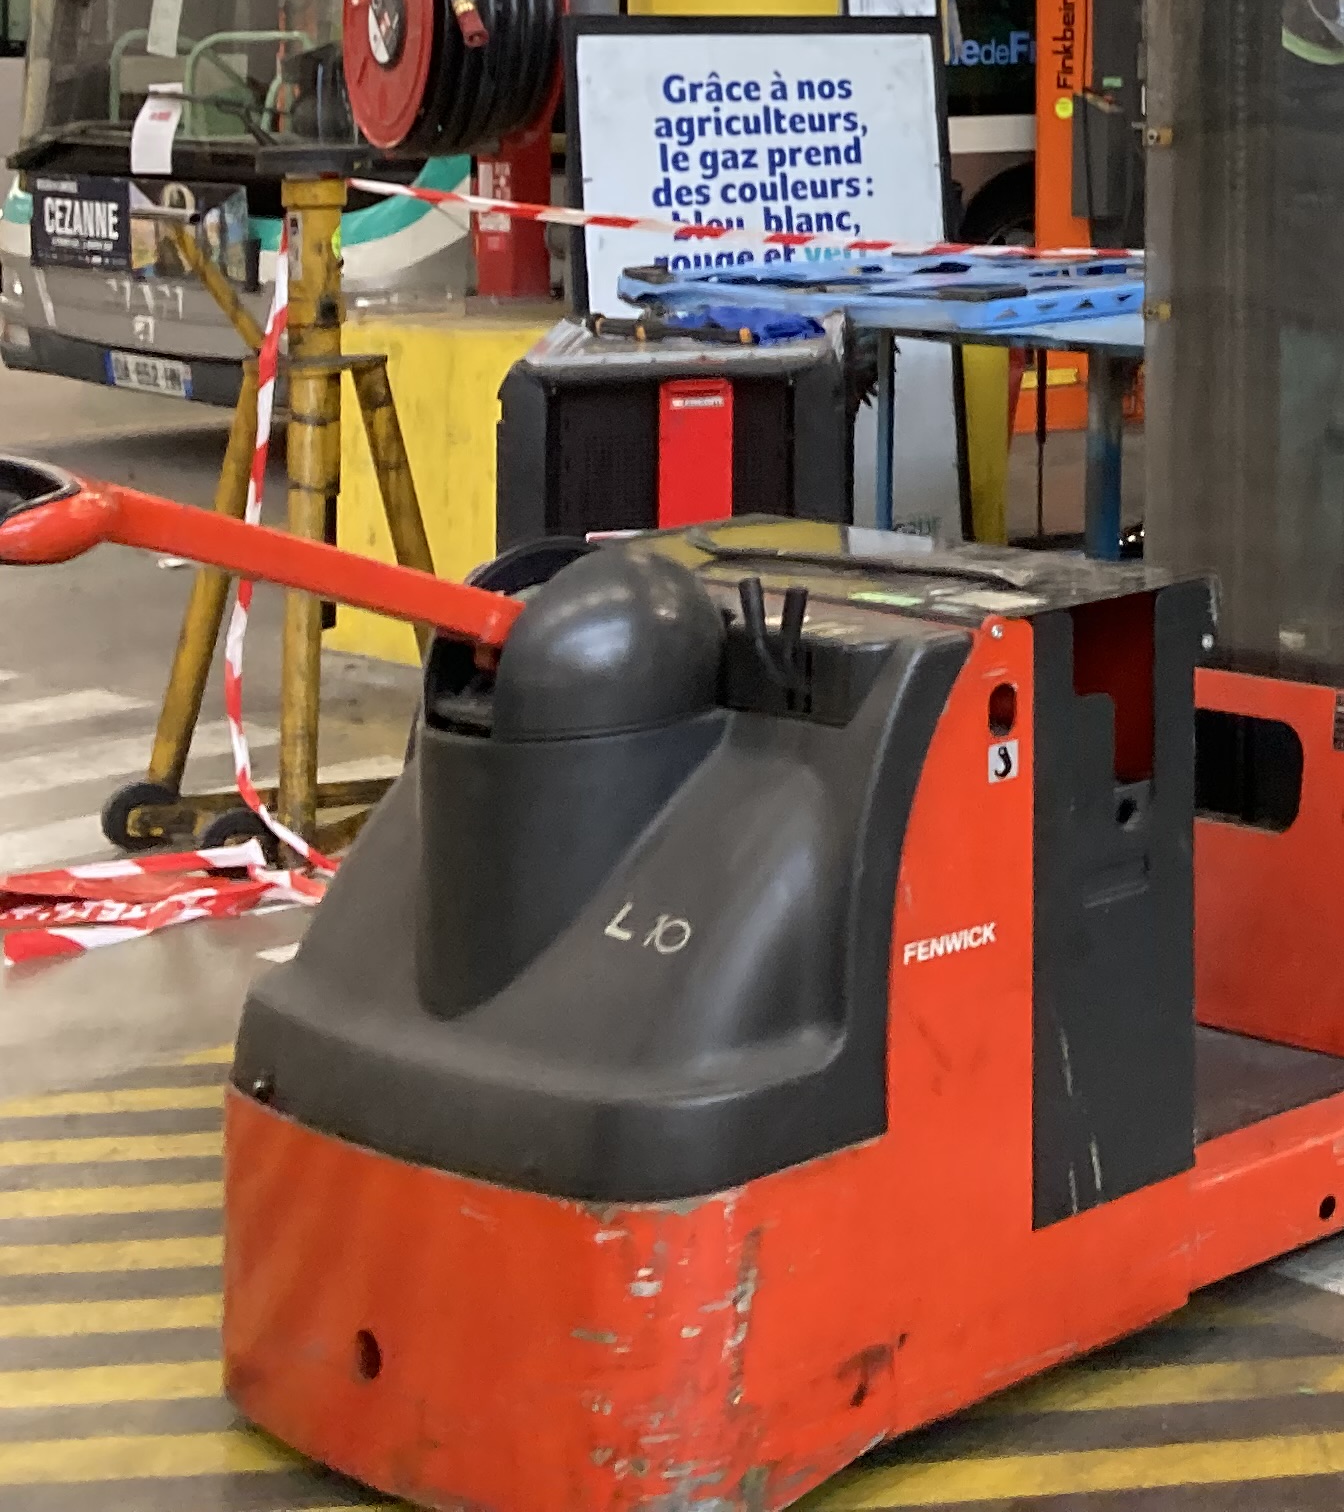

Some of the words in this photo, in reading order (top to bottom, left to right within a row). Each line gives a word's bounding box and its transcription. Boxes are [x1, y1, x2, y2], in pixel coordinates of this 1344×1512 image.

[662, 70, 761, 104] Grâce
[770, 70, 788, 101] à
[797, 79, 853, 101] nos
[654, 104, 869, 146] agriculteurs,
[659, 142, 690, 173] le
[699, 148, 759, 180] gaz
[767, 135, 863, 177] prend
[652, 176, 711, 207] des
[44, 196, 119, 241] CEZANNE
[763, 205, 861, 236] blanc,
[902, 921, 998, 965] FENWICK
